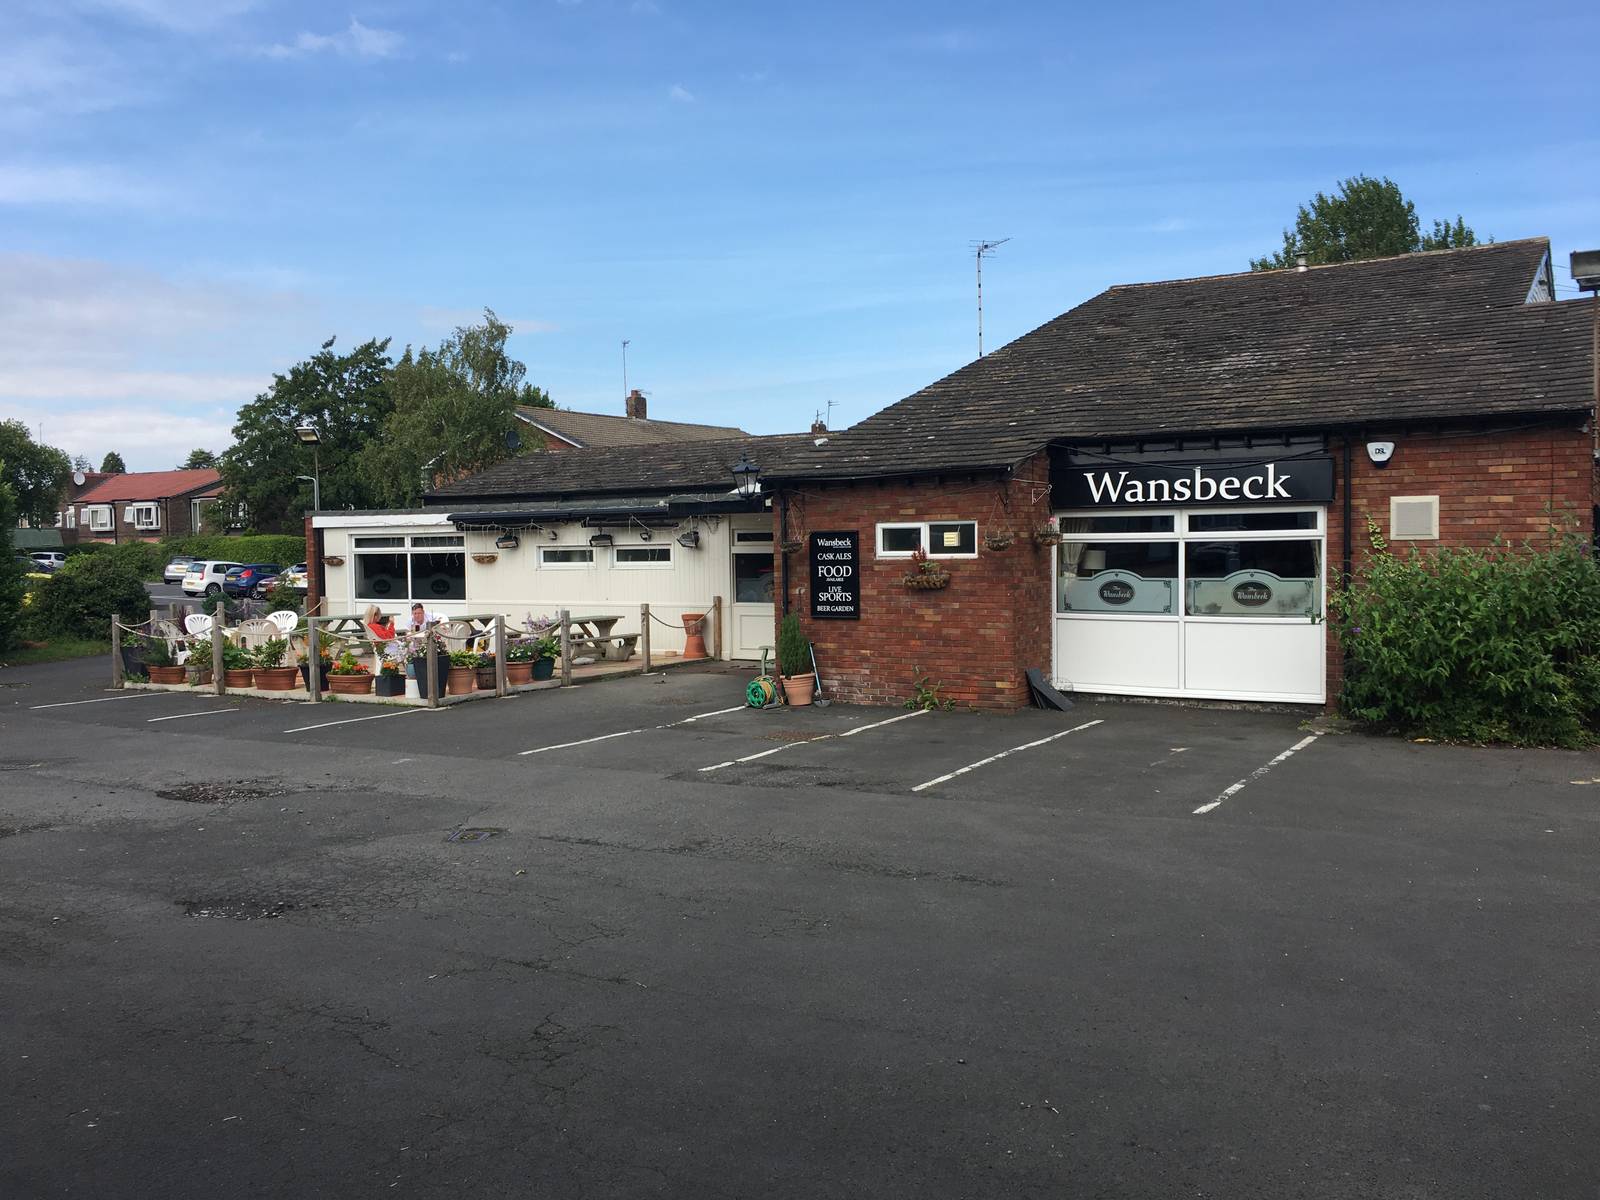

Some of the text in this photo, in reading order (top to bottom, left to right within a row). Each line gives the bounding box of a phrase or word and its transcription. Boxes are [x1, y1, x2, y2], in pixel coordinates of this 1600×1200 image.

[1083, 463, 1292, 503] Wansbeck
[817, 538, 852, 547] Wansbeck
[817, 552, 852, 561] CASK ALES
[817, 565, 852, 577] FOOD
[818, 592, 852, 602] SPORTS
